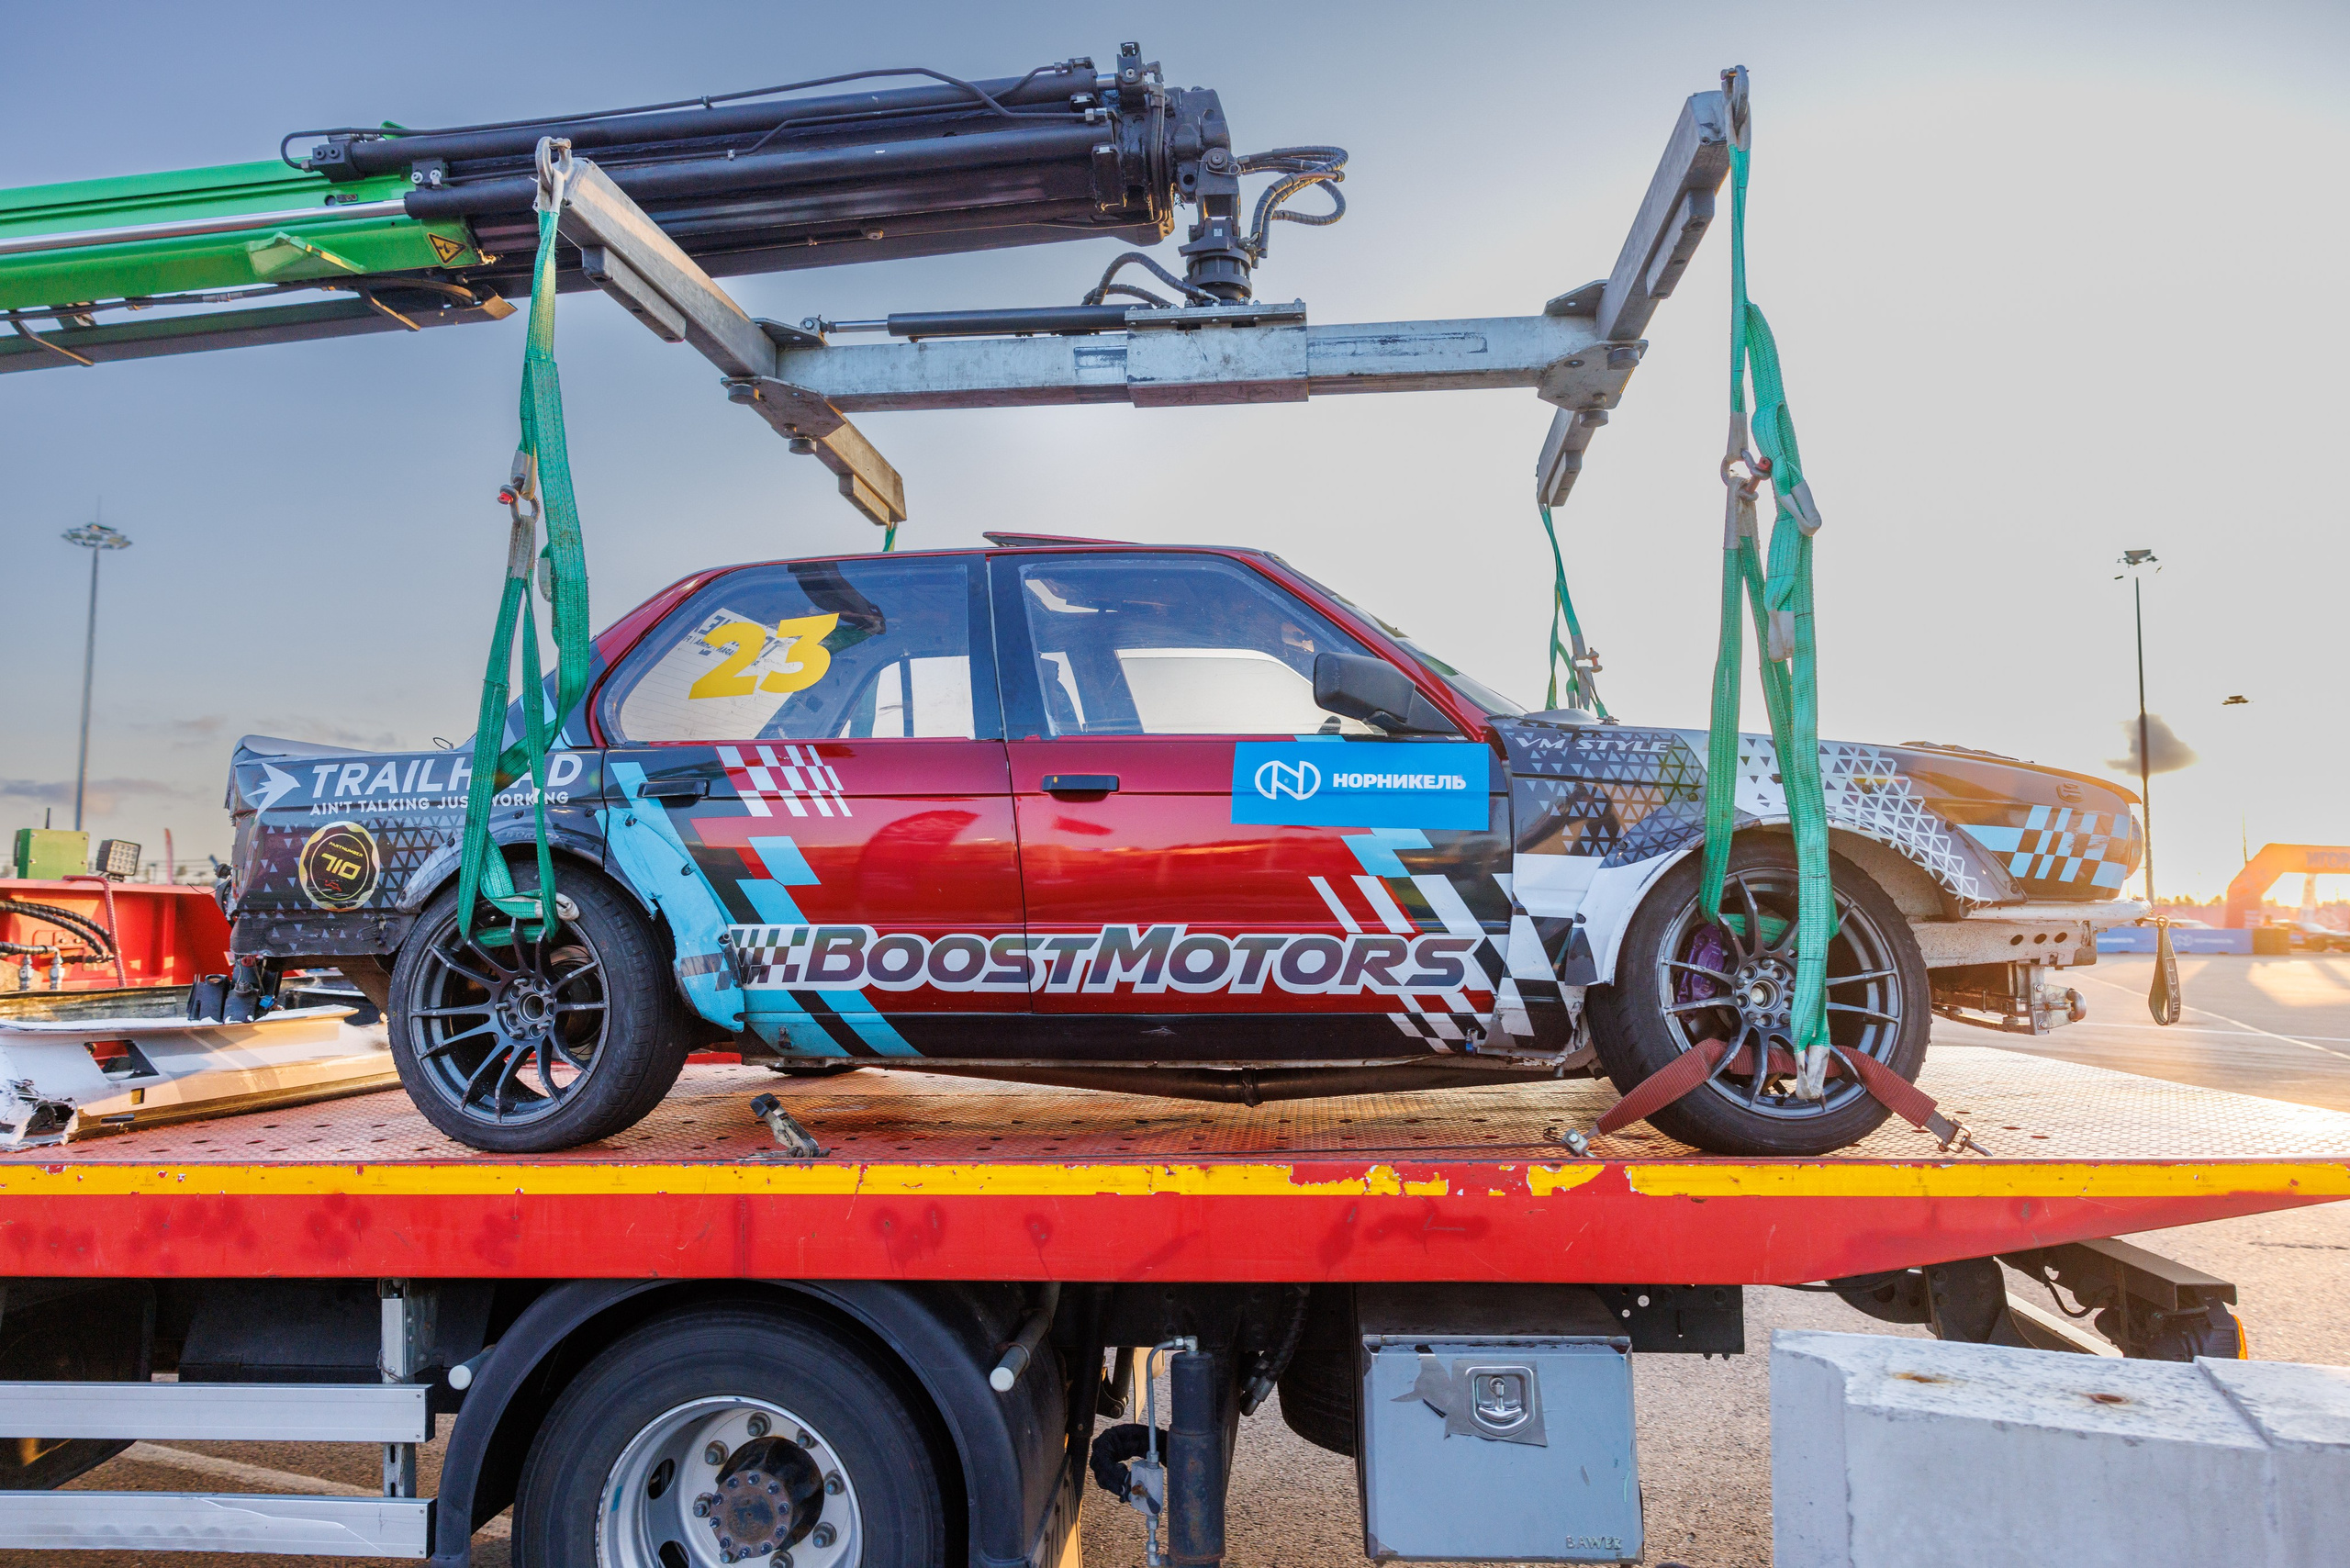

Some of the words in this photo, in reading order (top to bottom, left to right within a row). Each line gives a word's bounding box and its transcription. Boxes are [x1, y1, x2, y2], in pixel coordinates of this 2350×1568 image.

[688, 613, 839, 700] 23
[1516, 737, 1566, 749] VM
[1575, 739, 1672, 753] STYLE
[312, 754, 583, 798] TRAILHD
[1333, 773, 1467, 790] НОРНИКЕЛЬ
[309, 801, 352, 816] AIN'T
[357, 797, 431, 812] TALKING
[437, 795, 469, 809] JUS
[492, 791, 569, 807] ORKNG
[1565, 1535, 1623, 1551] BAWER
